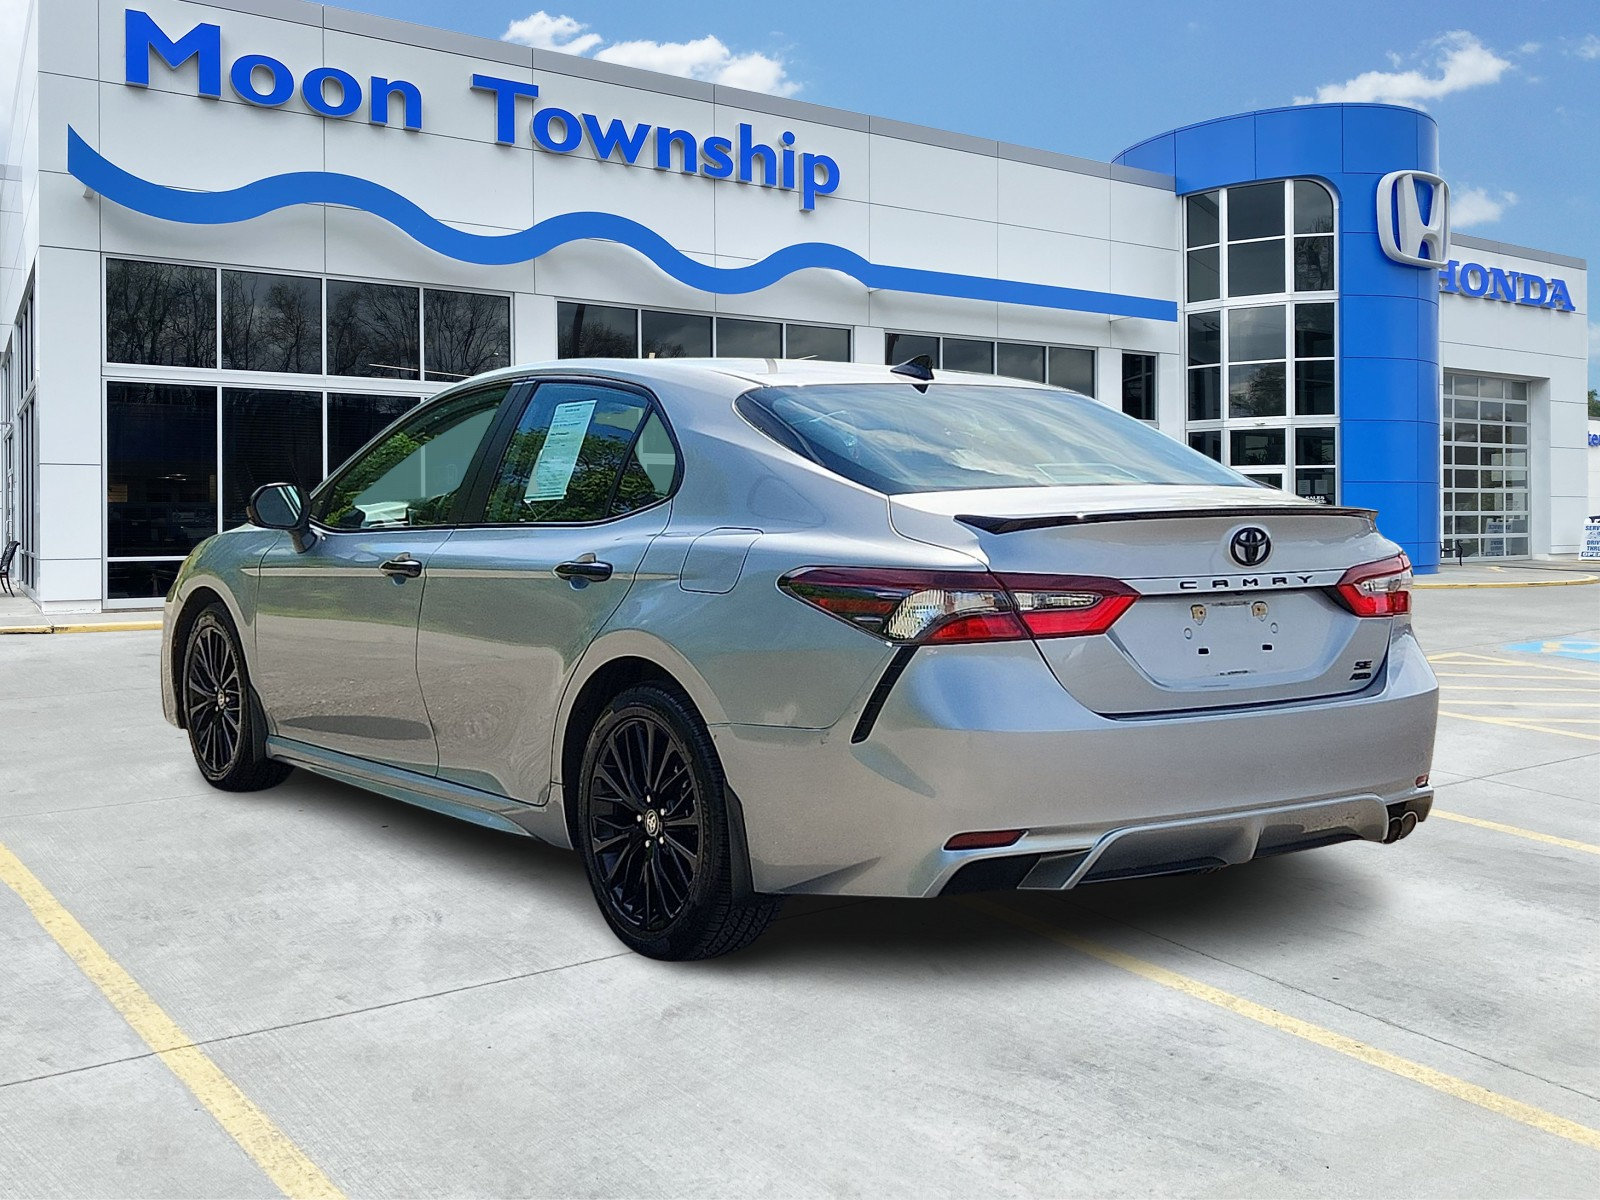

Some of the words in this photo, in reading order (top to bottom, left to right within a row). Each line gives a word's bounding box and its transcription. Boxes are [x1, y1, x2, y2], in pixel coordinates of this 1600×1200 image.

[125, 9, 421, 130] Moon
[470, 73, 841, 212] Township
[1438, 259, 1577, 313] HONDA
[1179, 575, 1314, 590] CAMRY
[1353, 660, 1373, 671] SE
